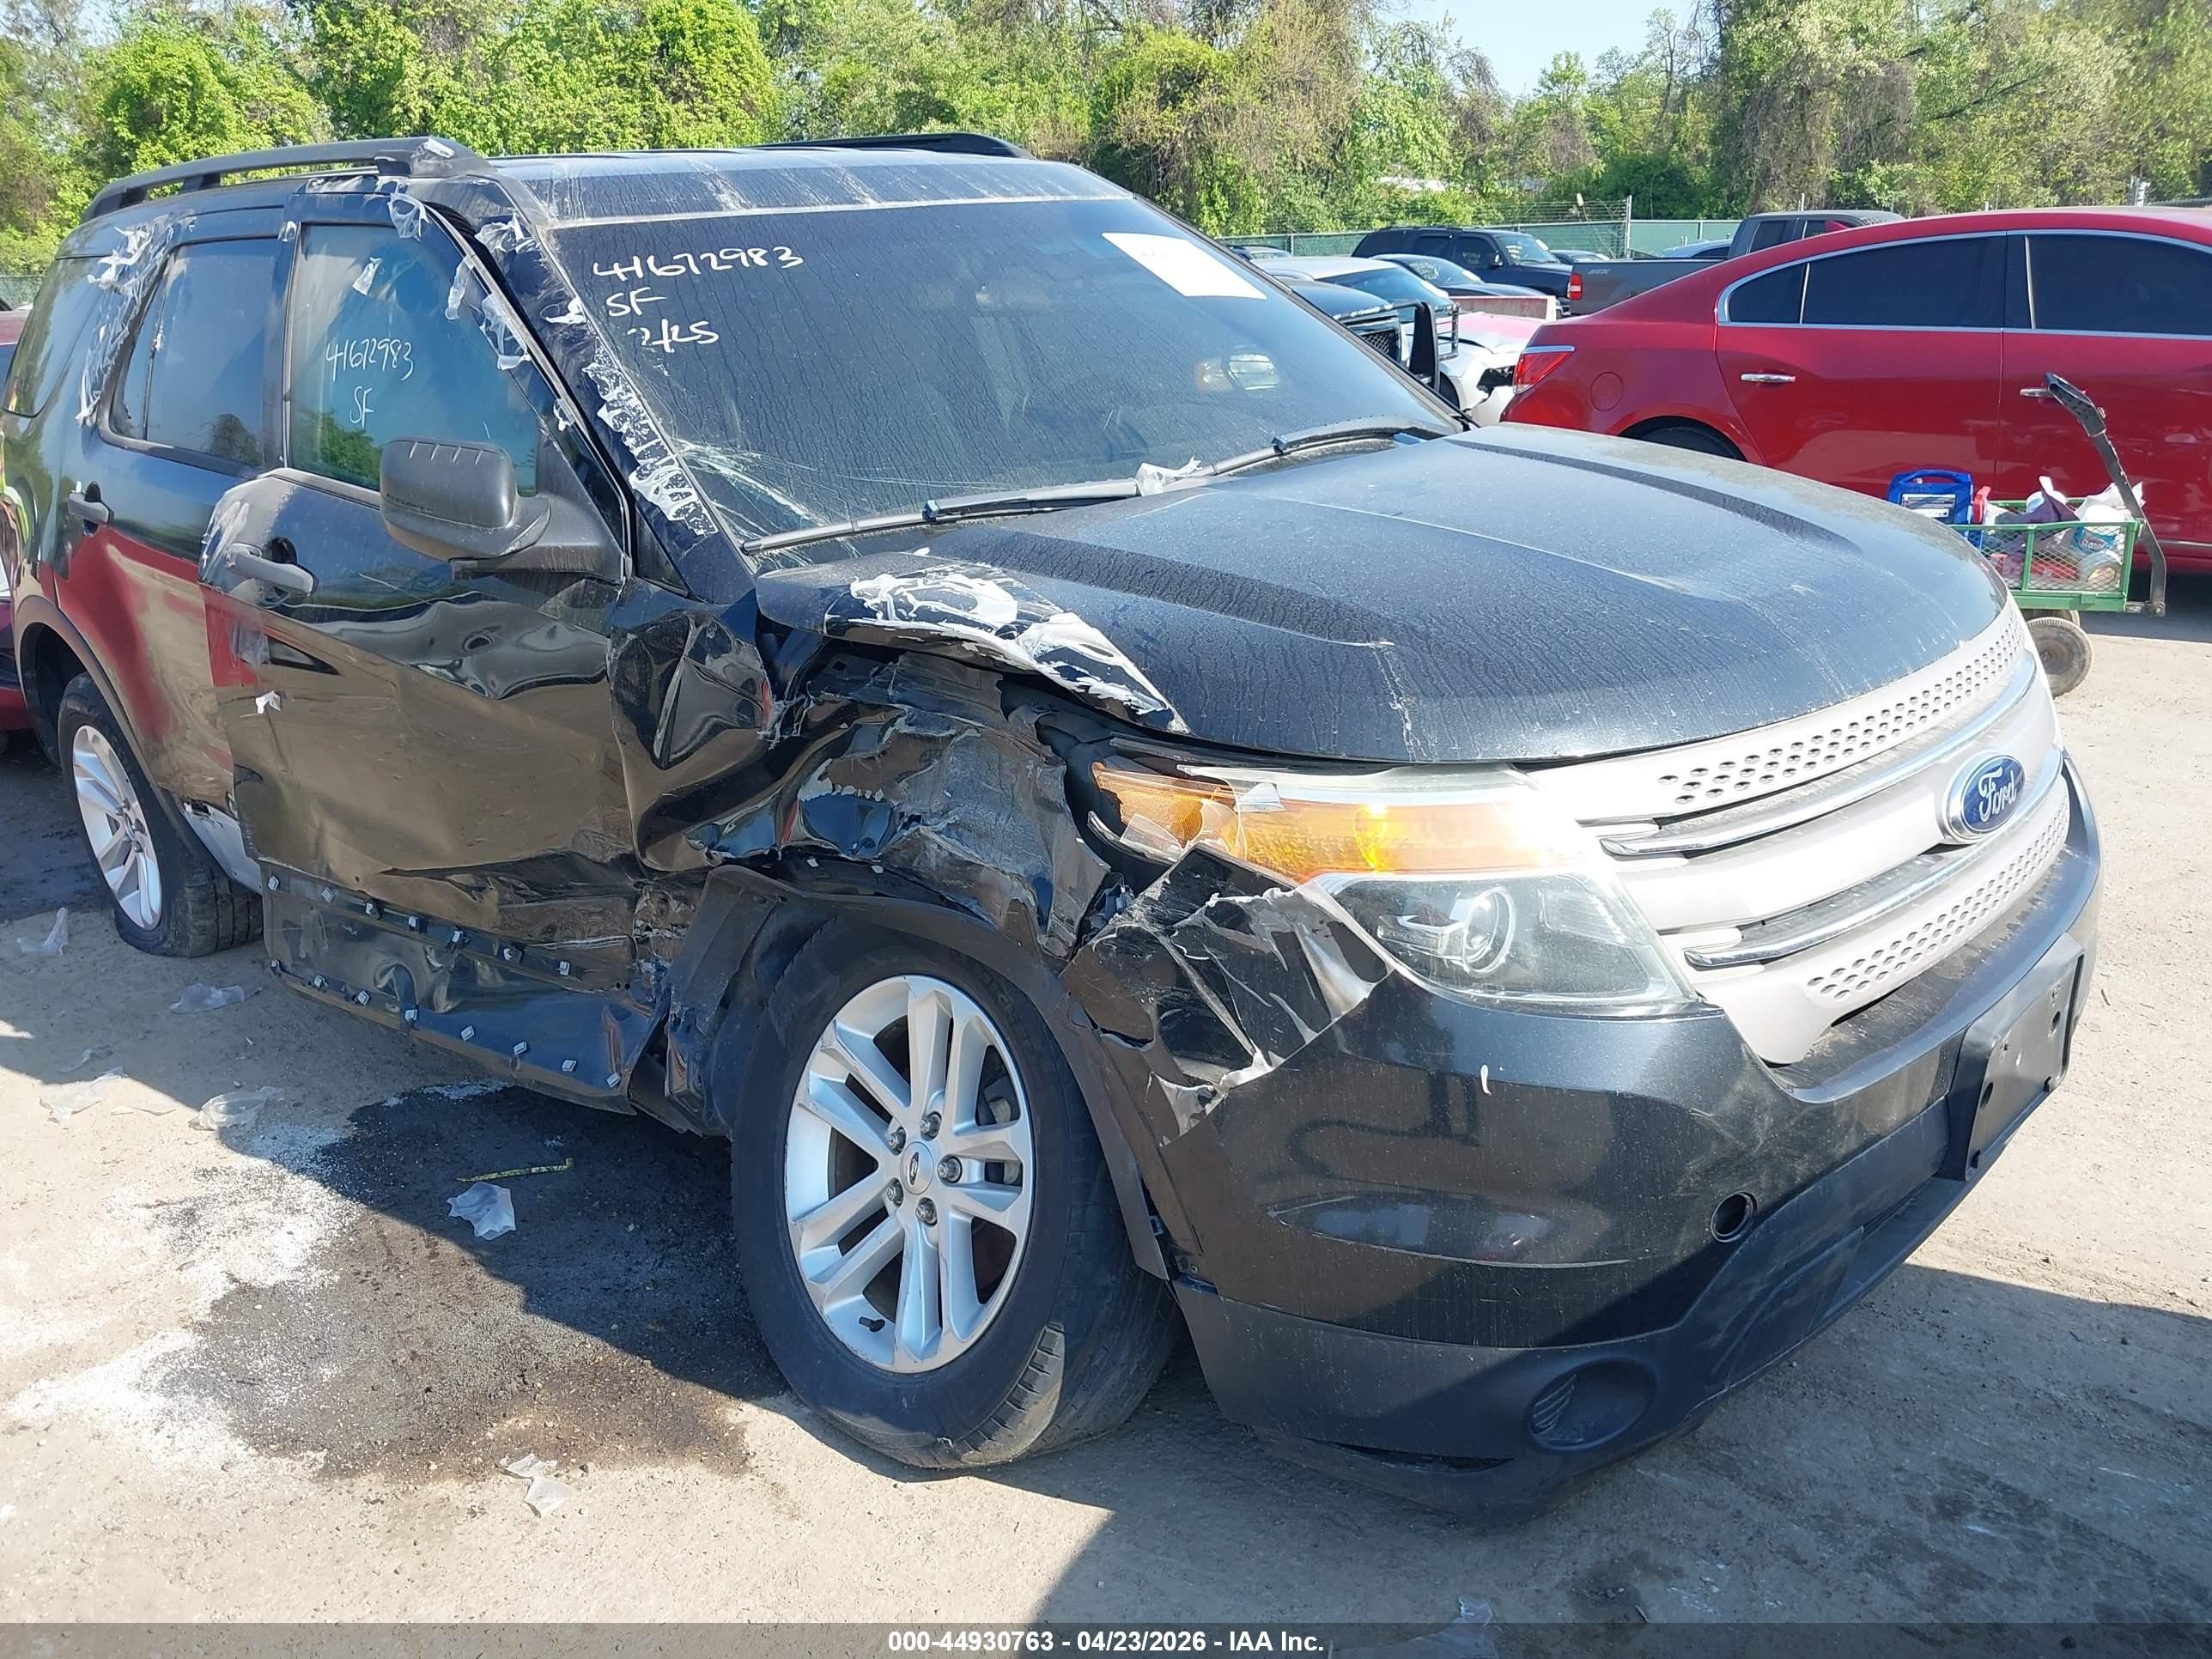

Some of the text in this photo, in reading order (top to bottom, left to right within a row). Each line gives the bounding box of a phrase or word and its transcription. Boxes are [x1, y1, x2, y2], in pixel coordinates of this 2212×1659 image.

[592, 246, 804, 282] 41672983
[605, 287, 667, 317] SF
[325, 337, 414, 382] 41672983
[349, 386, 375, 428] SF
[1978, 766, 2017, 823] Ford
